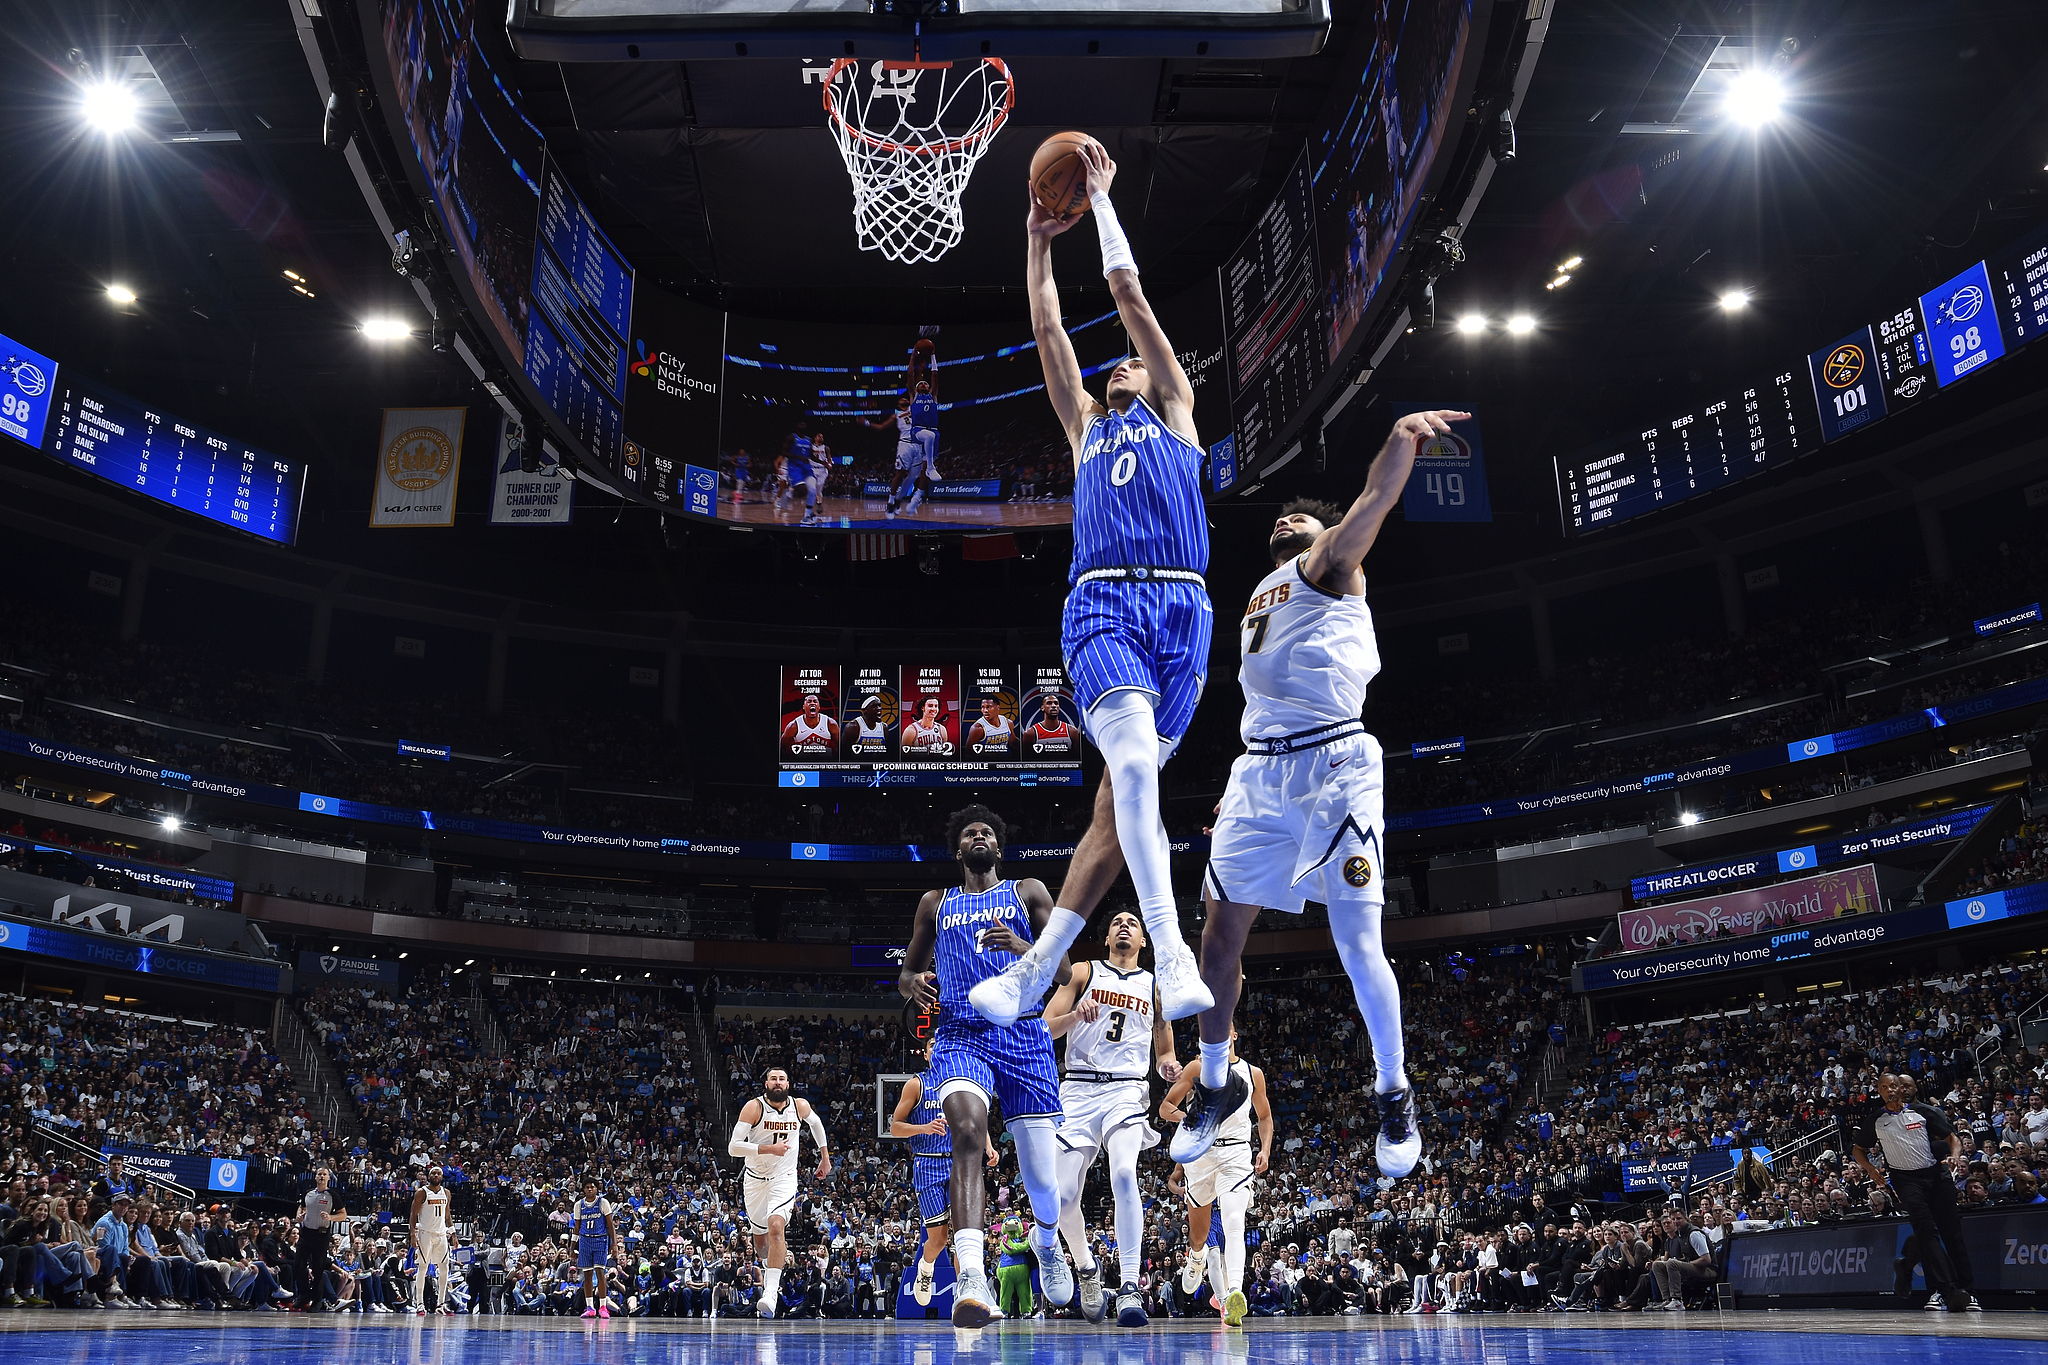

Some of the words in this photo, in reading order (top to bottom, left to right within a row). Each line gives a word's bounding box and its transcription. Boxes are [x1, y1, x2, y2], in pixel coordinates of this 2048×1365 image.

[2022, 247, 2048, 269] ISAAC
[2030, 283, 2043, 297] DA
[1880, 307, 1914, 336] 8:55
[1884, 332, 1899, 345] 4TH
[1899, 323, 1915, 337] QTR
[1950, 326, 1981, 358] 98
[1895, 342, 1909, 355] FLS
[1896, 352, 1911, 363] TOL
[659, 352, 686, 372] City
[1185, 346, 1222, 376] ational
[1899, 361, 1914, 373] CHL
[1958, 354, 1984, 372] BONUS
[657, 379, 692, 400] Bank
[658, 365, 716, 394] National
[1894, 382, 1910, 396] Hard
[1910, 374, 1926, 388] Rock
[2, 394, 30, 422] 98
[1641, 428, 1658, 441] PTS
[1672, 414, 1694, 430] REBS
[1706, 401, 1727, 417] ASTS
[1744, 388, 1756, 400] FG
[1775, 372, 1792, 386] FLS
[1833, 384, 1867, 417] 101
[0, 420, 24, 436] BONUS
[82, 397, 104, 413] ISAAC
[242, 462, 253, 474] 1/2
[409, 430, 442, 443] BUILDING
[1584, 452, 1625, 473] STRAWTHER
[1745, 400, 1758, 413] 5/6
[80, 409, 125, 436] RICHARDSON
[240, 474, 251, 485] 1/4
[144, 411, 161, 425] PTS
[174, 423, 196, 439] REBS
[206, 437, 228, 451] ASTS
[244, 450, 255, 461] FG
[273, 461, 289, 473] FLS
[1586, 469, 1612, 485] BROWN
[1748, 413, 1759, 425] 1/3
[77, 422, 88, 434] DA
[88, 427, 109, 443] SILVA
[237, 486, 250, 498] 5/9
[655, 457, 672, 470] 8:55
[1111, 451, 1137, 486] 0
[1587, 474, 1636, 497] VALANCIUNAS
[1749, 425, 1762, 438] 2/3
[75, 435, 95, 451] BANE
[234, 498, 249, 511] 6/10
[624, 464, 636, 482] 101
[1220, 464, 1232, 480] 98
[1589, 492, 1619, 510] MURRAY
[1750, 437, 1765, 451] 8/17
[72, 448, 96, 465] BLACK
[231, 510, 248, 523] 10/19
[506, 483, 541, 494] TURNER
[543, 482, 561, 494] CUP
[932, 486, 945, 494] Zero
[946, 486, 958, 494] Trust
[958, 485, 982, 494] Security
[1426, 474, 1466, 506] 49
[1591, 507, 1612, 522] JONES
[1754, 451, 1766, 463] 4/7
[506, 494, 558, 506] CHAMPIONS
[692, 492, 708, 506] 98
[511, 508, 551, 518] 2000-2001
[1979, 610, 2036, 632] THREATLOCKER
[800, 670, 808, 678] AT
[809, 670, 822, 678] TOR
[860, 669, 869, 677] AT
[869, 669, 881, 677] IND
[920, 669, 929, 677] AT
[929, 669, 941, 677] CHI
[979, 669, 988, 677] VS
[989, 669, 1000, 677] IND
[1037, 669, 1046, 677] AT
[1046, 669, 1061, 677] WAS
[401, 744, 446, 756] THREATLOCKER
[1416, 742, 1462, 753] THREATLOCKER
[28, 742, 54, 756] Your
[55, 749, 128, 774] cybersecurity
[129, 764, 159, 780] home
[160, 768, 192, 782] game
[192, 778, 246, 796] advantage
[1517, 799, 1540, 811] Your
[1542, 788, 1610, 808] cybersecurity
[1612, 782, 1642, 794] home
[1643, 771, 1675, 786] game
[1676, 764, 1731, 782] advantage
[542, 830, 564, 840] Your
[566, 833, 630, 848] cybersecurity
[632, 837, 660, 849] home
[660, 838, 690, 847] game
[690, 843, 740, 855] advantage
[1647, 862, 1758, 892] THREATLOCKER
[1842, 842, 1868, 855] Zero
[1870, 834, 1900, 849] Trust
[1902, 824, 1951, 846] Security
[152, 874, 196, 890] Security
[1763, 892, 1824, 922] World
[975, 928, 987, 954] 1
[1612, 965, 1641, 981] Your
[1644, 954, 1730, 976] cybersecurity
[1734, 946, 1770, 962] home
[1770, 928, 1810, 948] game
[1813, 924, 1885, 949] advantage
[340, 960, 379, 971] FANDUEL
[1091, 989, 1149, 1016] NUGGETS
[1105, 1011, 1127, 1042] 3
[764, 1121, 797, 1130] NUGGETS
[1628, 1161, 1688, 1175] THREALOCKER
[1630, 1178, 1646, 1186] Zero
[435, 1206, 442, 1216] 11
[586, 1220, 594, 1229] 11
[1742, 1247, 1868, 1278] THREATLOCKER
